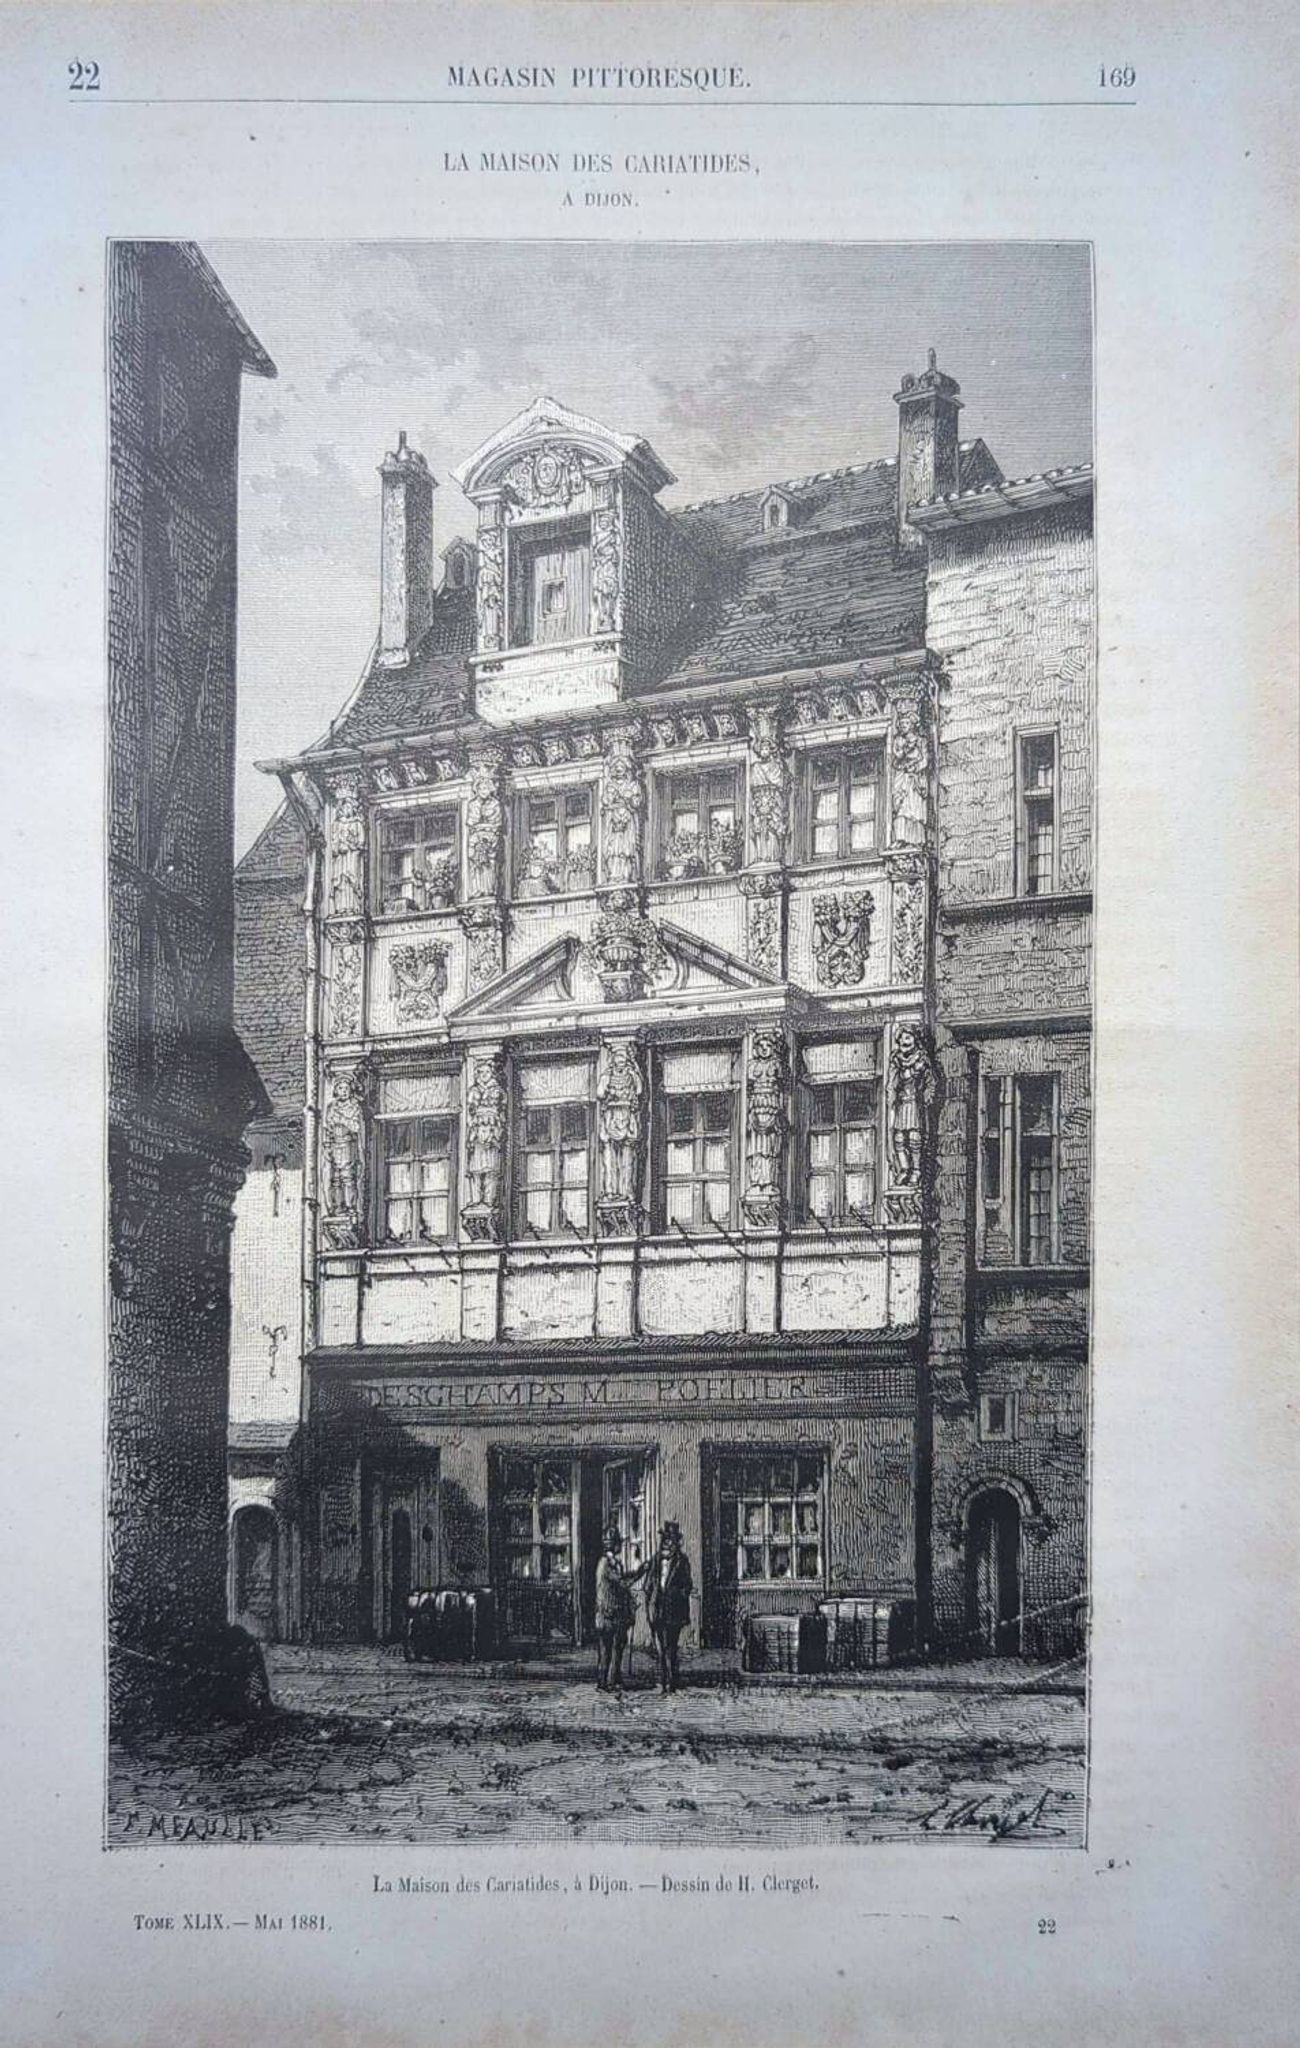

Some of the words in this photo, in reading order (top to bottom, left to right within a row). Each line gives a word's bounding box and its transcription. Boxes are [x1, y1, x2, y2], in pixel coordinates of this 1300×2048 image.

[67, 57, 101, 92] 22
[447, 65, 556, 88] MAGASIN
[572, 66, 751, 93] PITTORESQUE.
[1099, 62, 1137, 88] 169
[443, 152, 470, 172] LA
[480, 152, 560, 173] MAISON
[573, 152, 613, 173] DES
[624, 153, 760, 176] CARIATIDES,
[584, 192, 639, 208] DIJON.
[372, 1873, 393, 1893] La
[397, 1874, 450, 1894] Maison
[455, 1874, 481, 1894] des
[486, 1873, 568, 1895] Cariatides,
[573, 1874, 582, 1892] à
[588, 1873, 633, 1897] Dijon.
[661, 1873, 710, 1894] Dessin
[715, 1872, 733, 1893] de
[738, 1874, 755, 1894] H.
[762, 1873, 820, 1895] Clerget.
[290, 1914, 333, 1932] 1881.
[1037, 1918, 1057, 1935] 22
